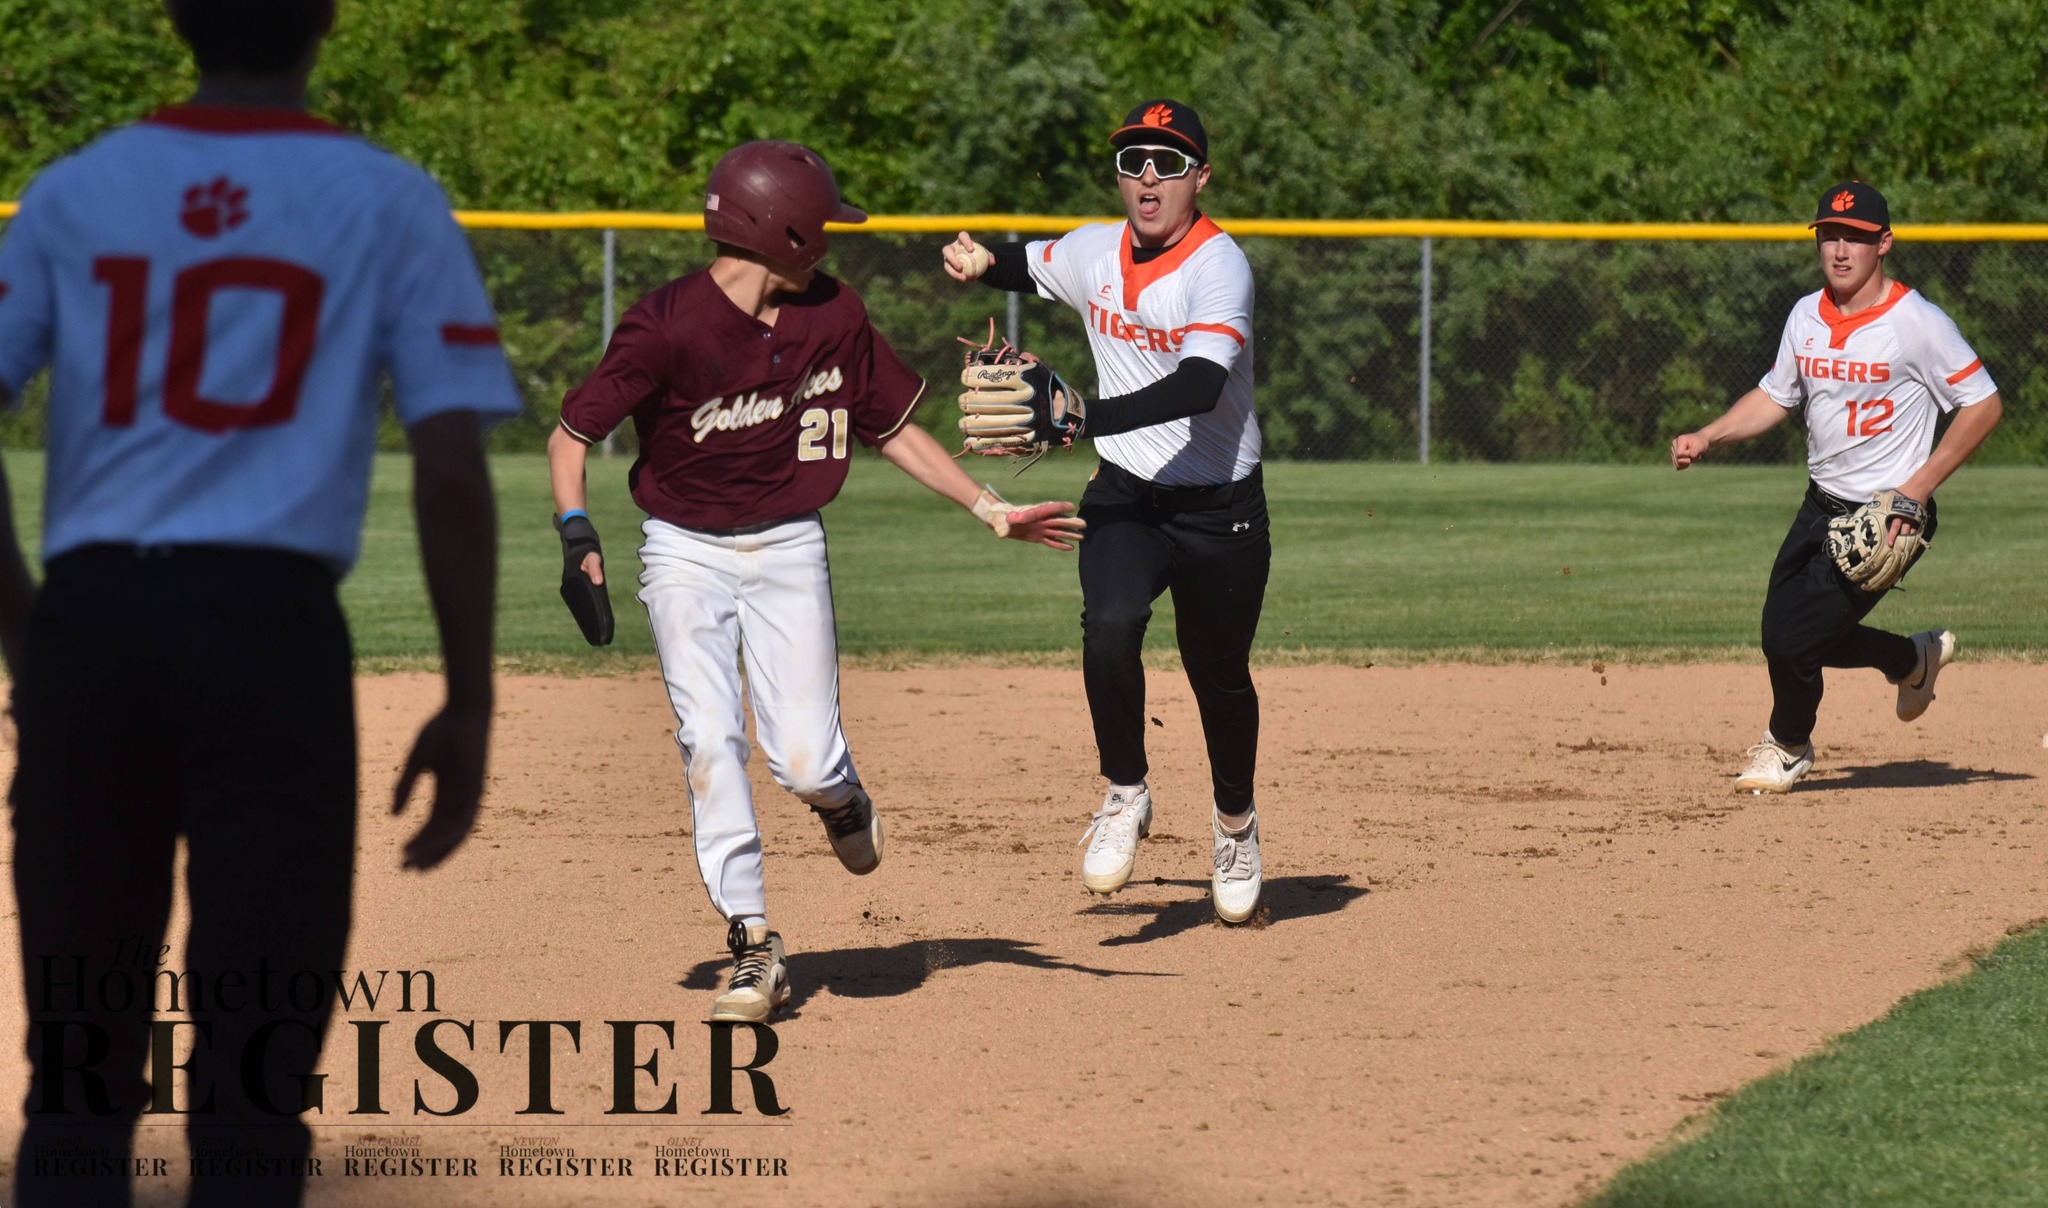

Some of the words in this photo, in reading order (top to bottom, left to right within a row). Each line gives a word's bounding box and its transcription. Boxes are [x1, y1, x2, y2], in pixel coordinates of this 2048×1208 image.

[94, 255, 325, 435] 10
[1088, 300, 1186, 353] TIGERS
[1795, 355, 1891, 384] TIGERS
[690, 392, 784, 443] Golden
[798, 408, 848, 462] 21
[1845, 398, 1895, 437] 12
